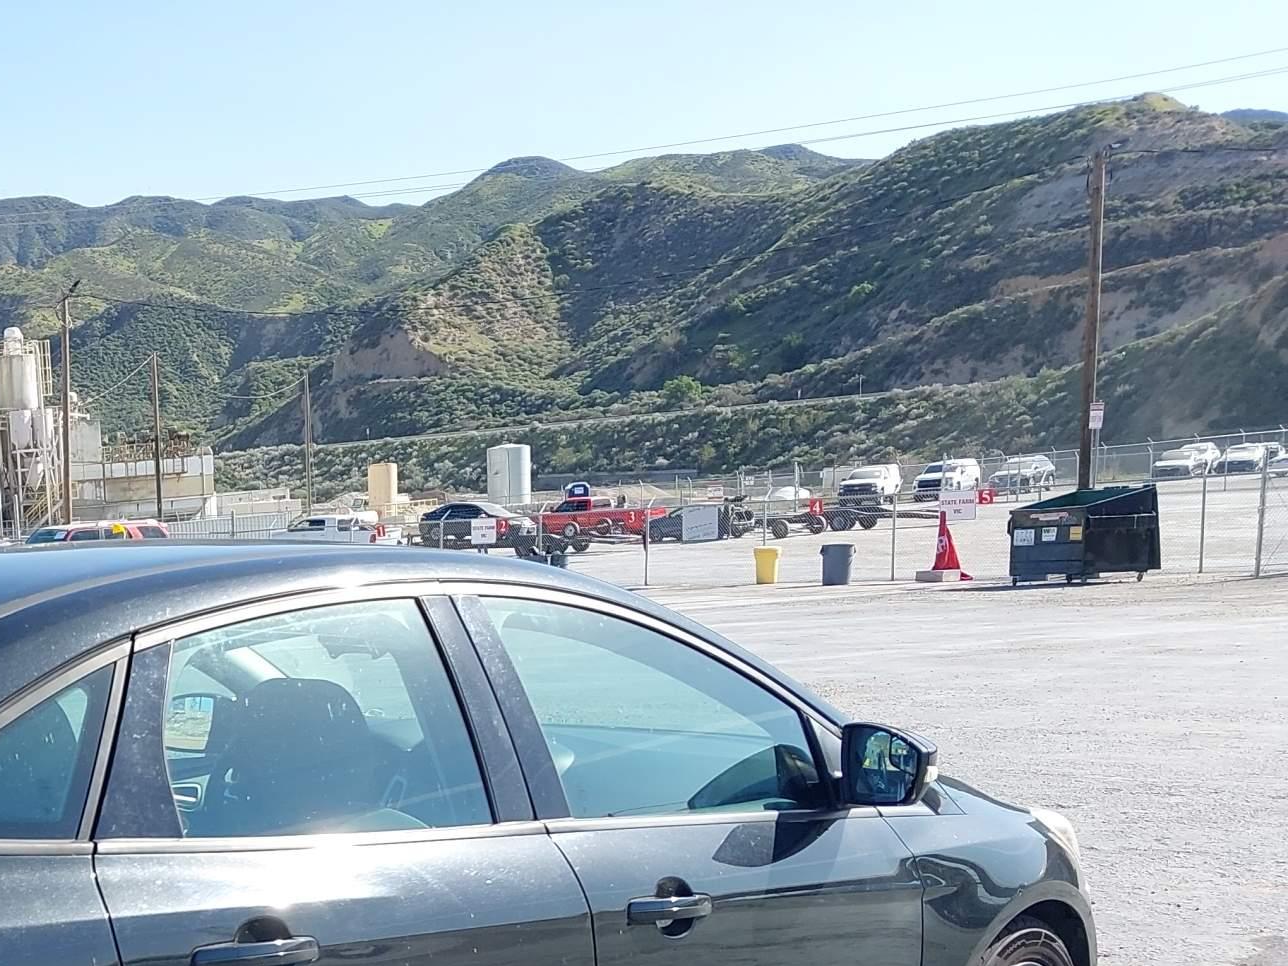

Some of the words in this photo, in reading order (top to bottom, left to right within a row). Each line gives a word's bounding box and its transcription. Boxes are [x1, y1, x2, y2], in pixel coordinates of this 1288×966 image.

[981, 490, 991, 504] 5
[812, 500, 820, 513] 4
[628, 511, 635, 523] 3
[499, 520, 507, 532] 2
